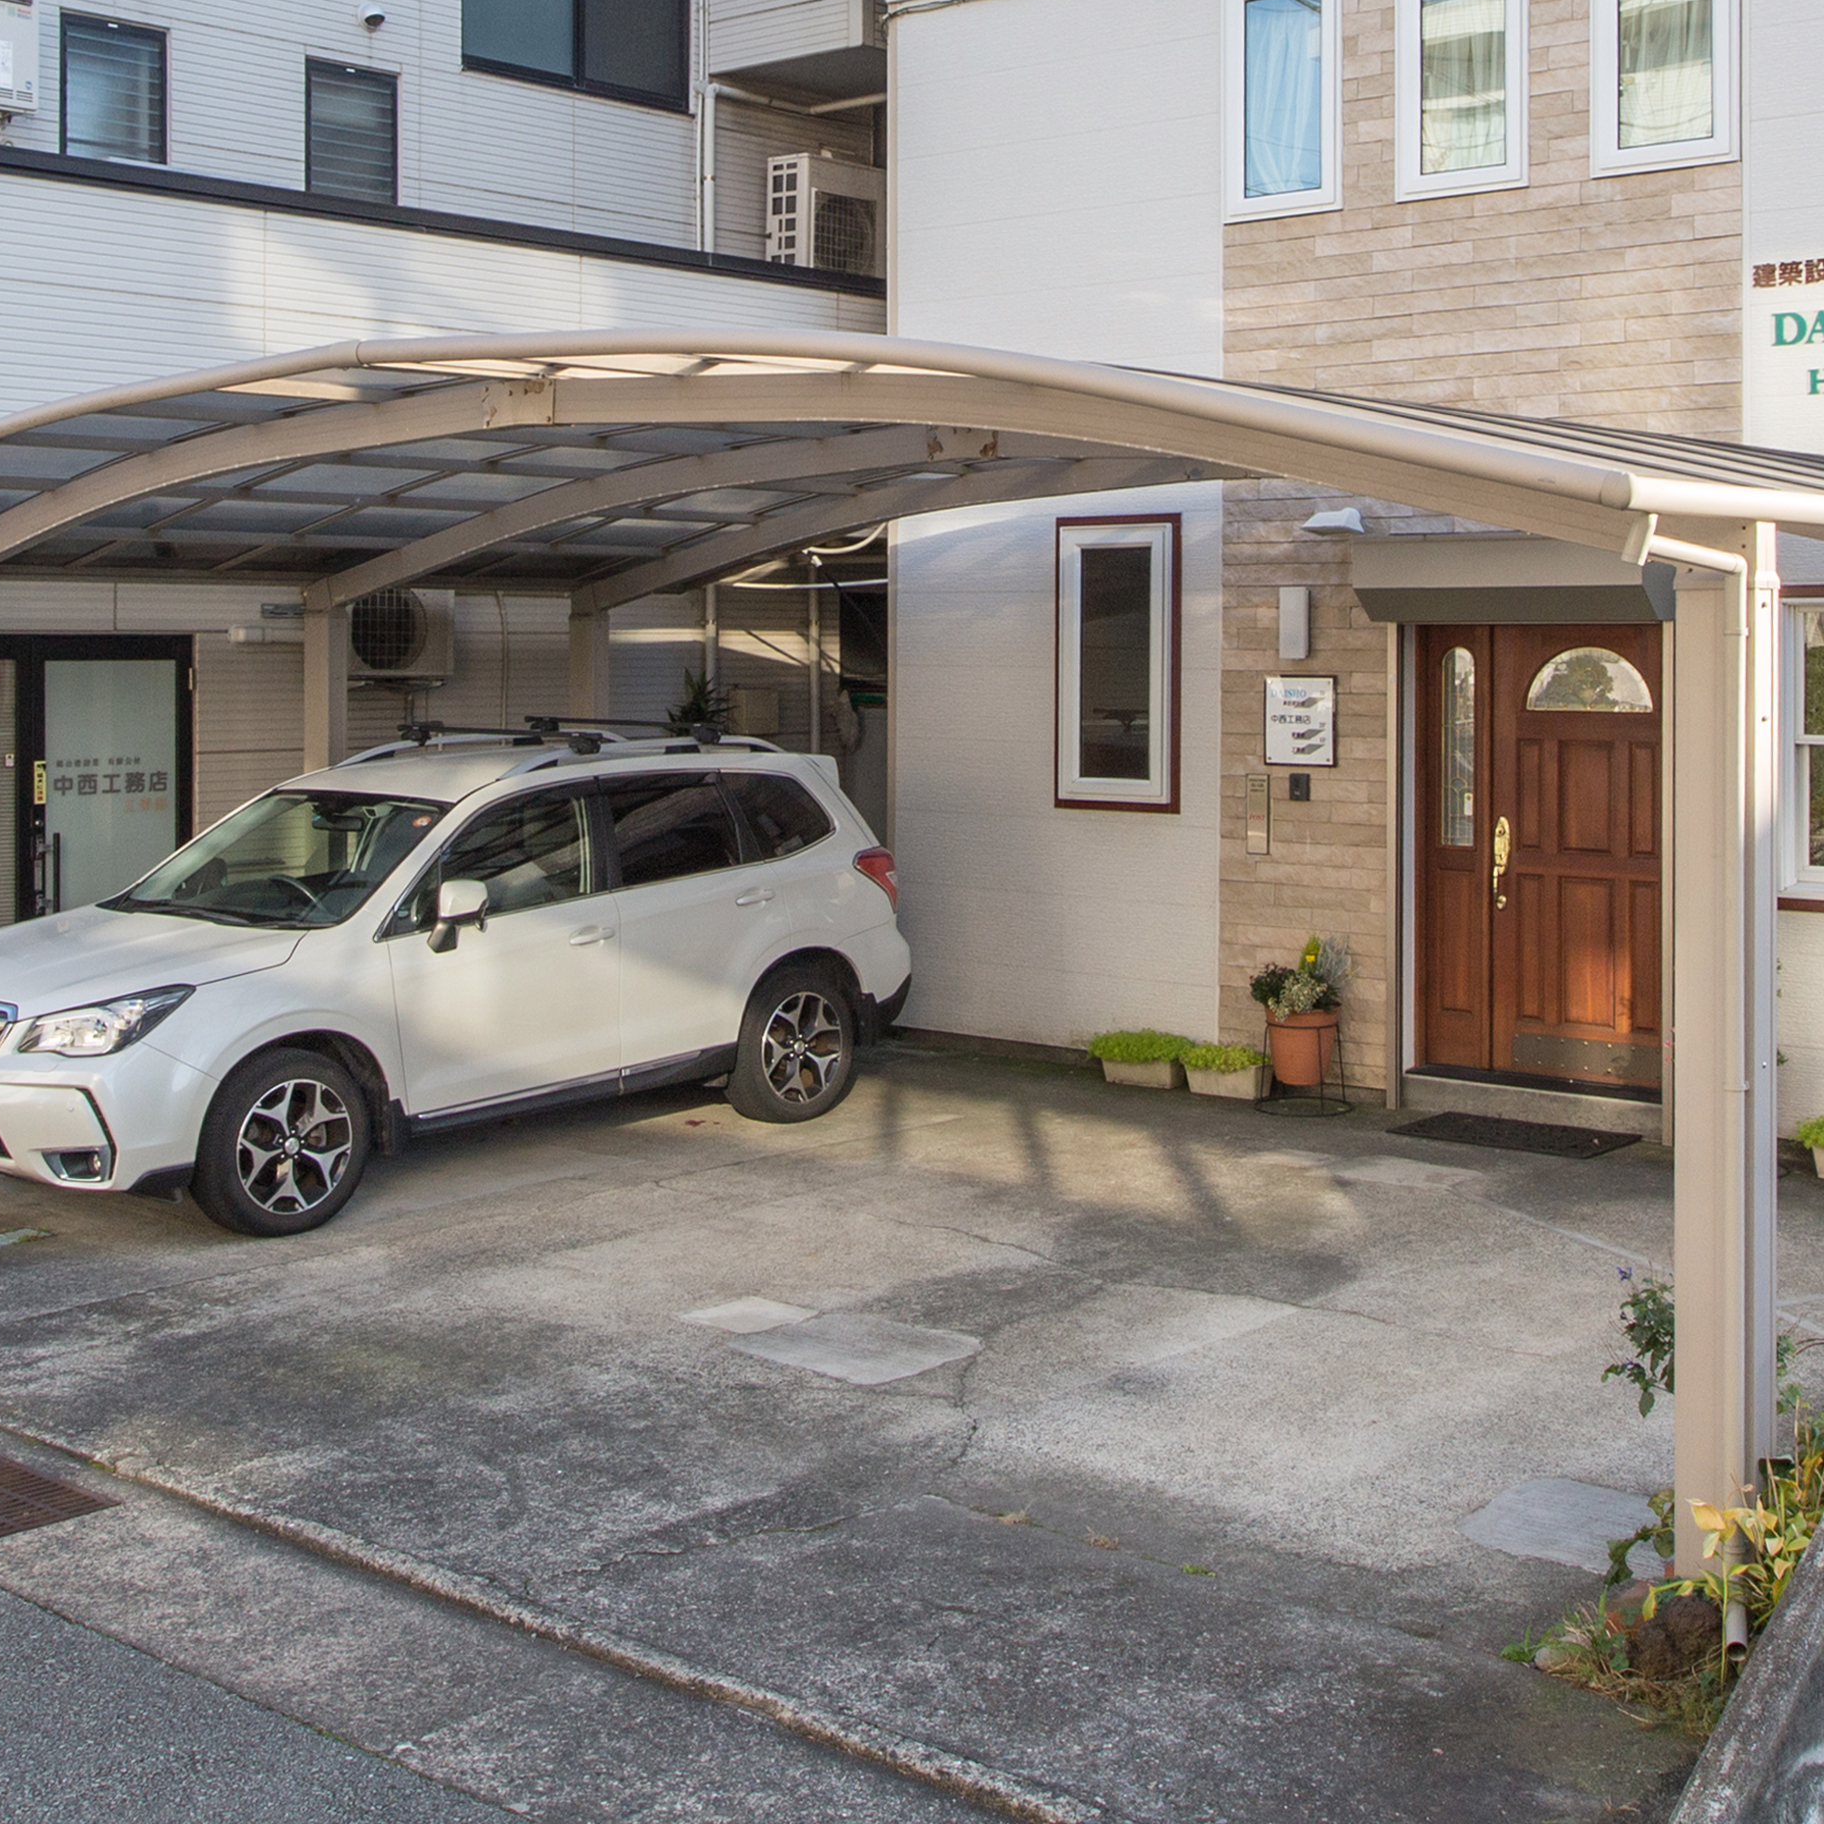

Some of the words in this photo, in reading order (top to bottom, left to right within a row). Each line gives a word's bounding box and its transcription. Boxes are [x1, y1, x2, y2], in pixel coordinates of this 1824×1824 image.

[53, 770, 168, 797] 中西工務店
